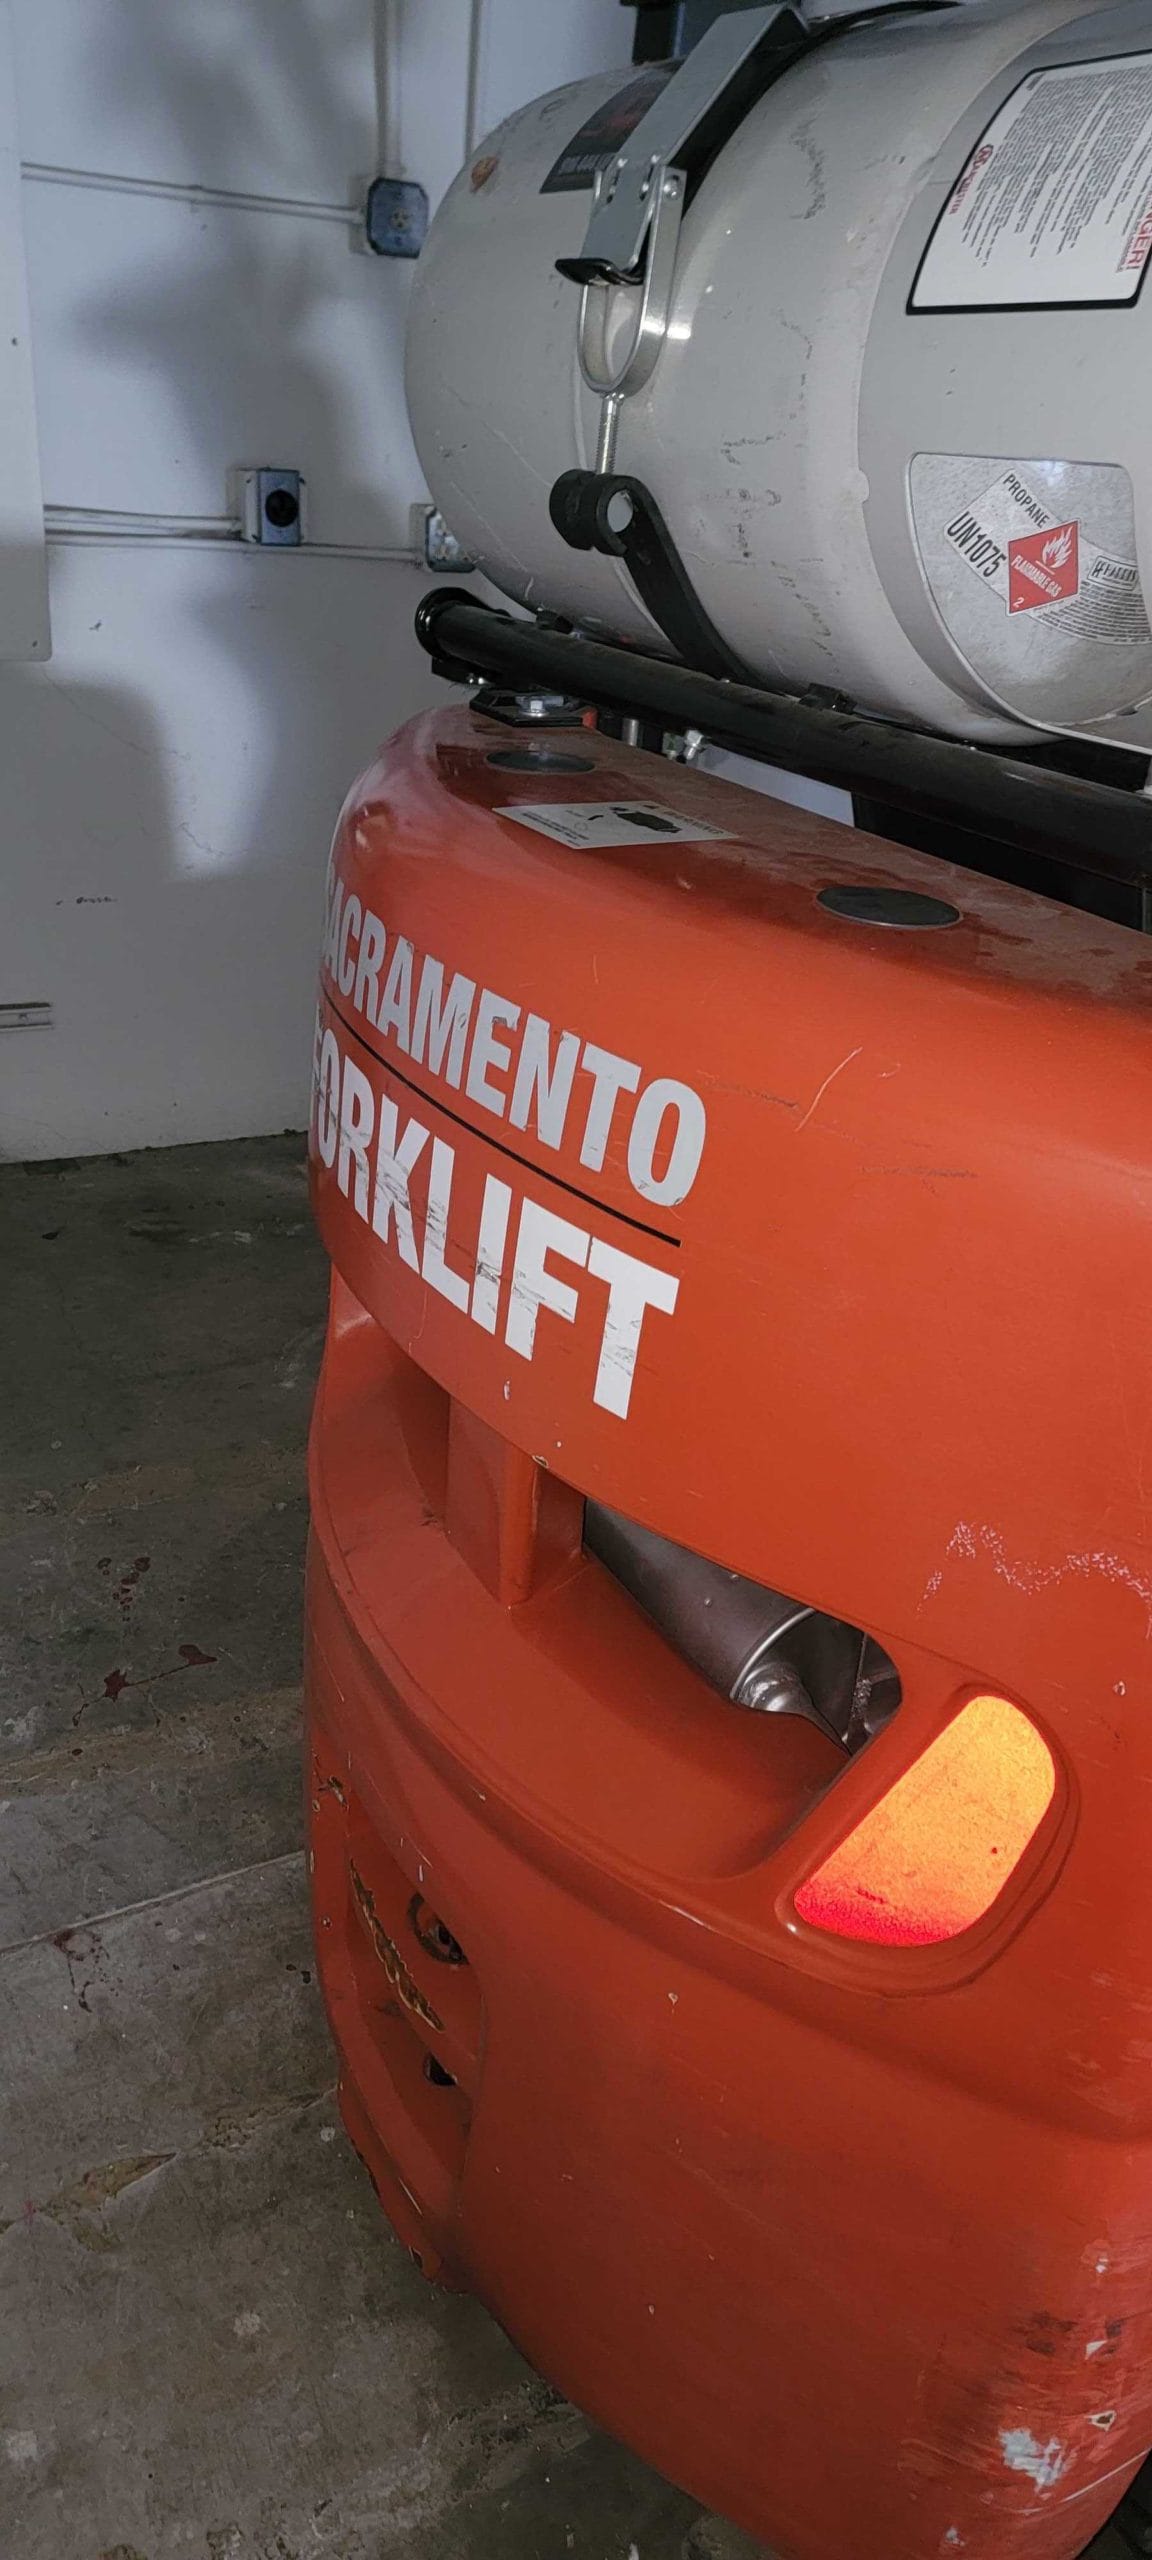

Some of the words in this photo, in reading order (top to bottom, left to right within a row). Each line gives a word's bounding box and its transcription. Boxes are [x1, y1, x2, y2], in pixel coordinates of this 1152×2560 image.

[1003, 474, 1049, 528] PROPANE
[947, 511, 1006, 577] UN1075
[1013, 597, 1024, 607] 2
[1048, 577, 1062, 597] GAS
